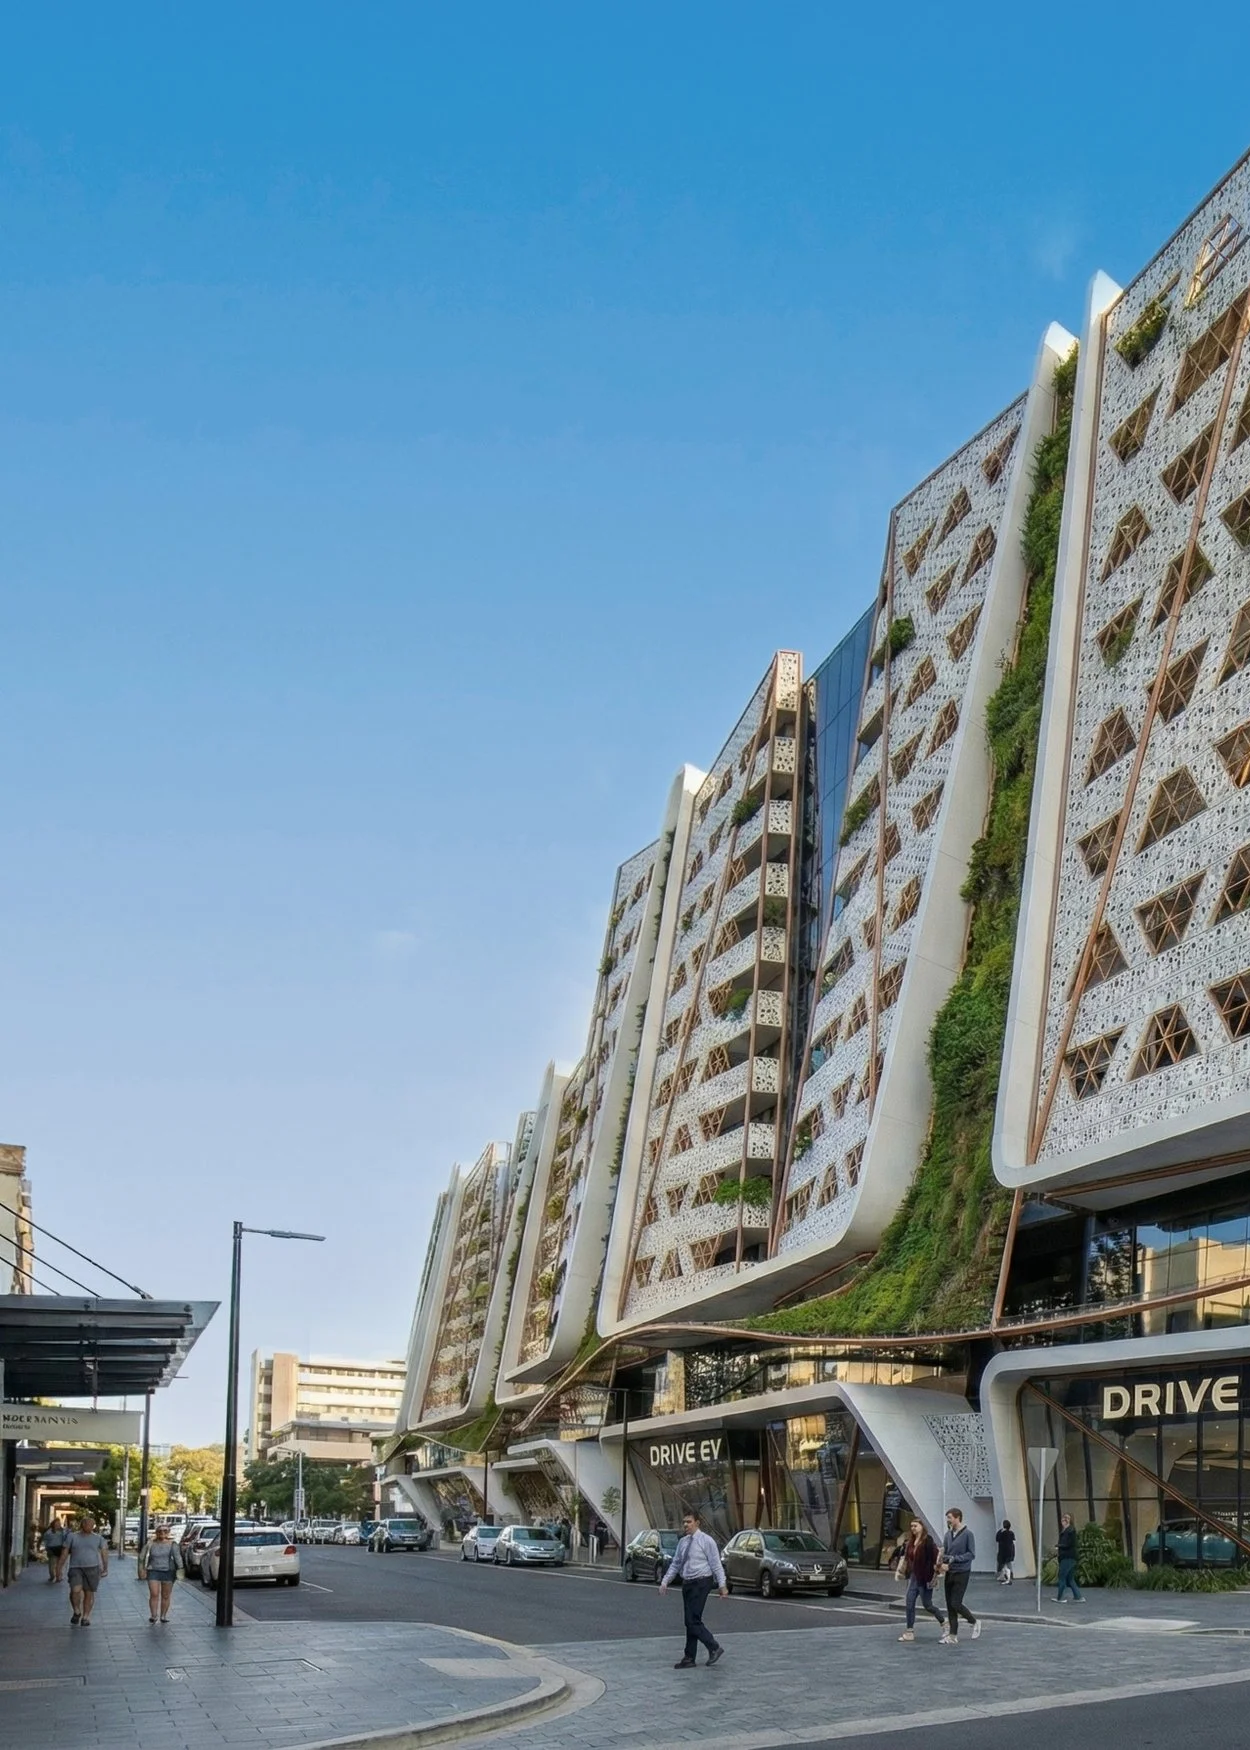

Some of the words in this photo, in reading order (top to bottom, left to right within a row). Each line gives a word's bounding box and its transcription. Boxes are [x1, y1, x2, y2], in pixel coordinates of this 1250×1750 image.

[1103, 1375, 1239, 1419] DRIVE
[650, 1441, 696, 1466] DRIVE
[700, 1438, 722, 1461] EV
